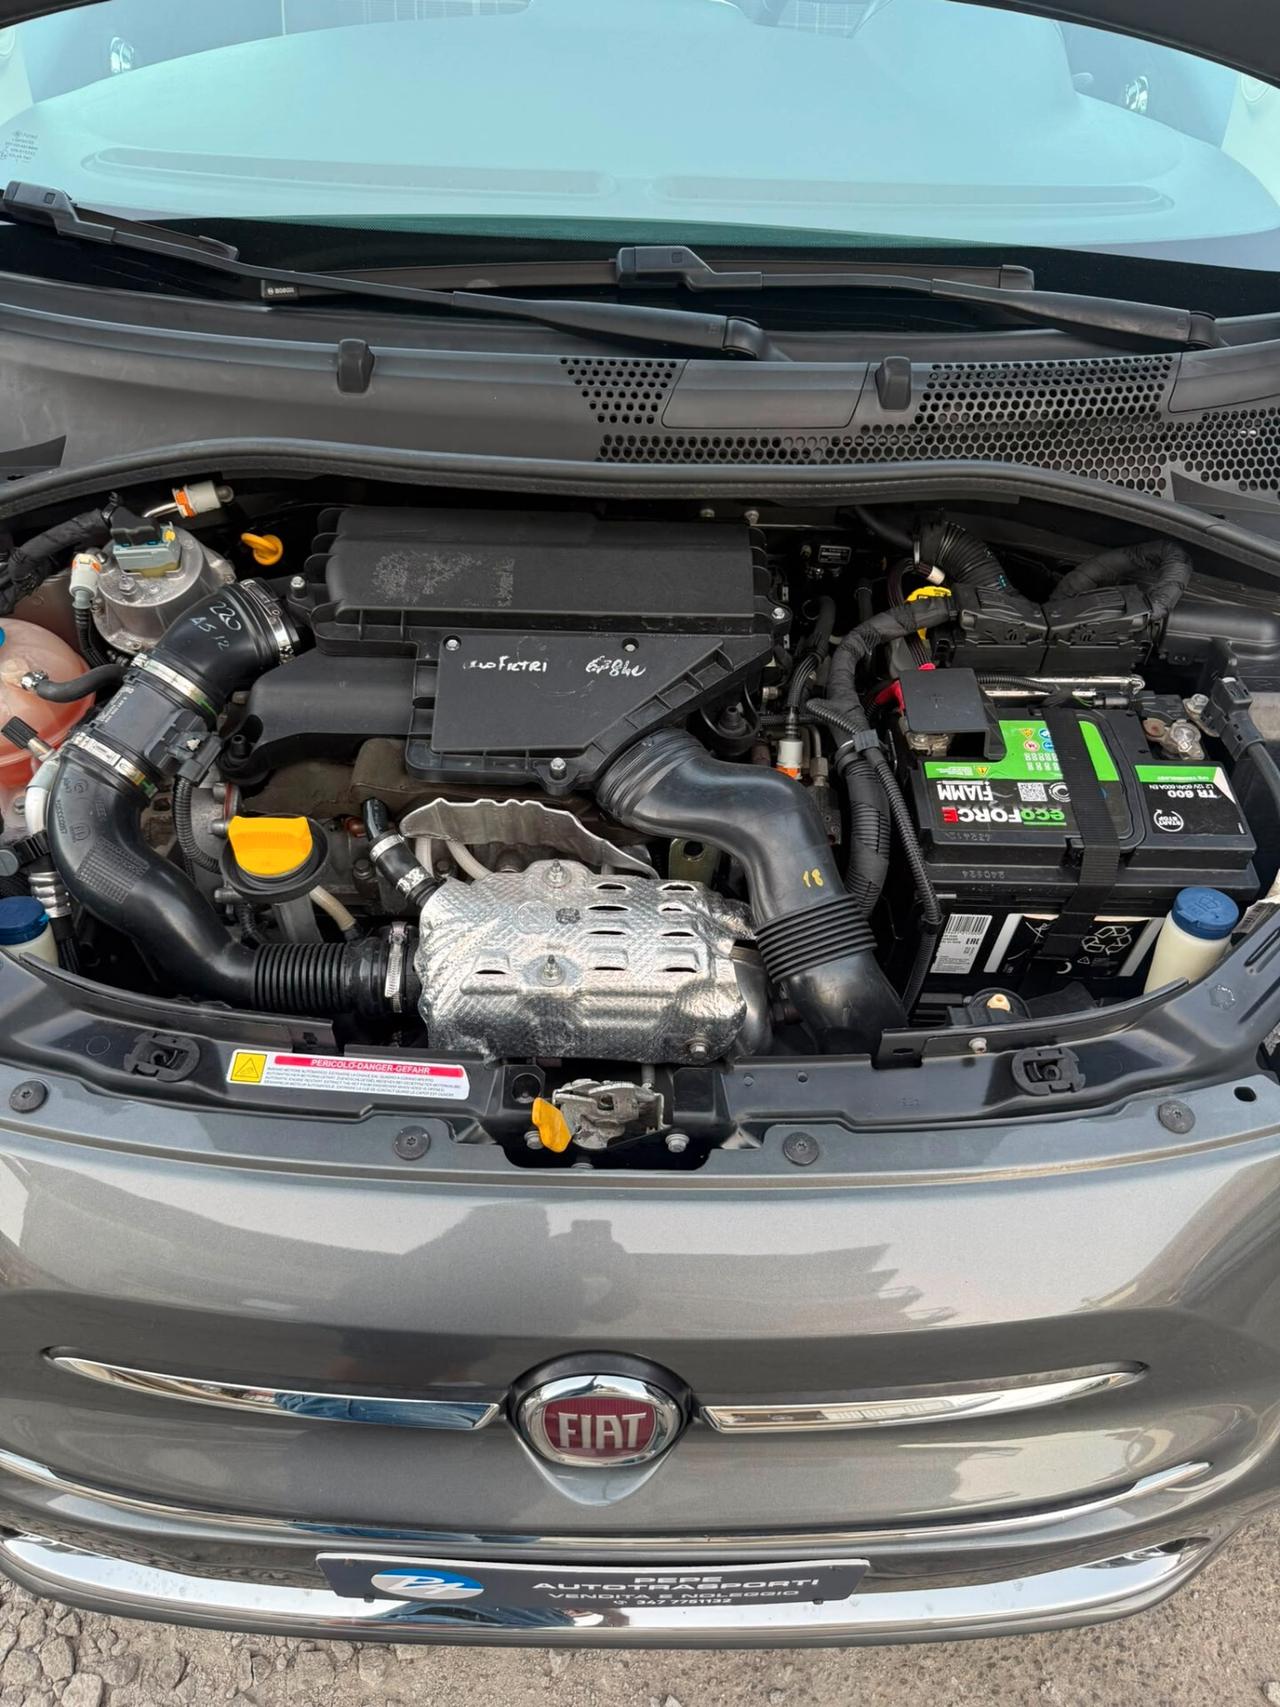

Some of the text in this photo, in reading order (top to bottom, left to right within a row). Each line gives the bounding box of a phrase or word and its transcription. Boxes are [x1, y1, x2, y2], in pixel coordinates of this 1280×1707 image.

[209, 601, 242, 631] 220
[936, 784, 994, 801] FIAMM
[1167, 789, 1217, 798] TR 600
[941, 806, 1066, 823] ecoFORCE
[803, 868, 824, 888] 18
[311, 1058, 431, 1074] PERICOLO-DANGER-GEFAHR
[558, 1412, 647, 1449] FIAT
[532, 1578, 819, 1590] AUTOTRASPORTI
[634, 1576, 723, 1584] PEPE
[681, 1590, 800, 1599] NOLEGGIO
